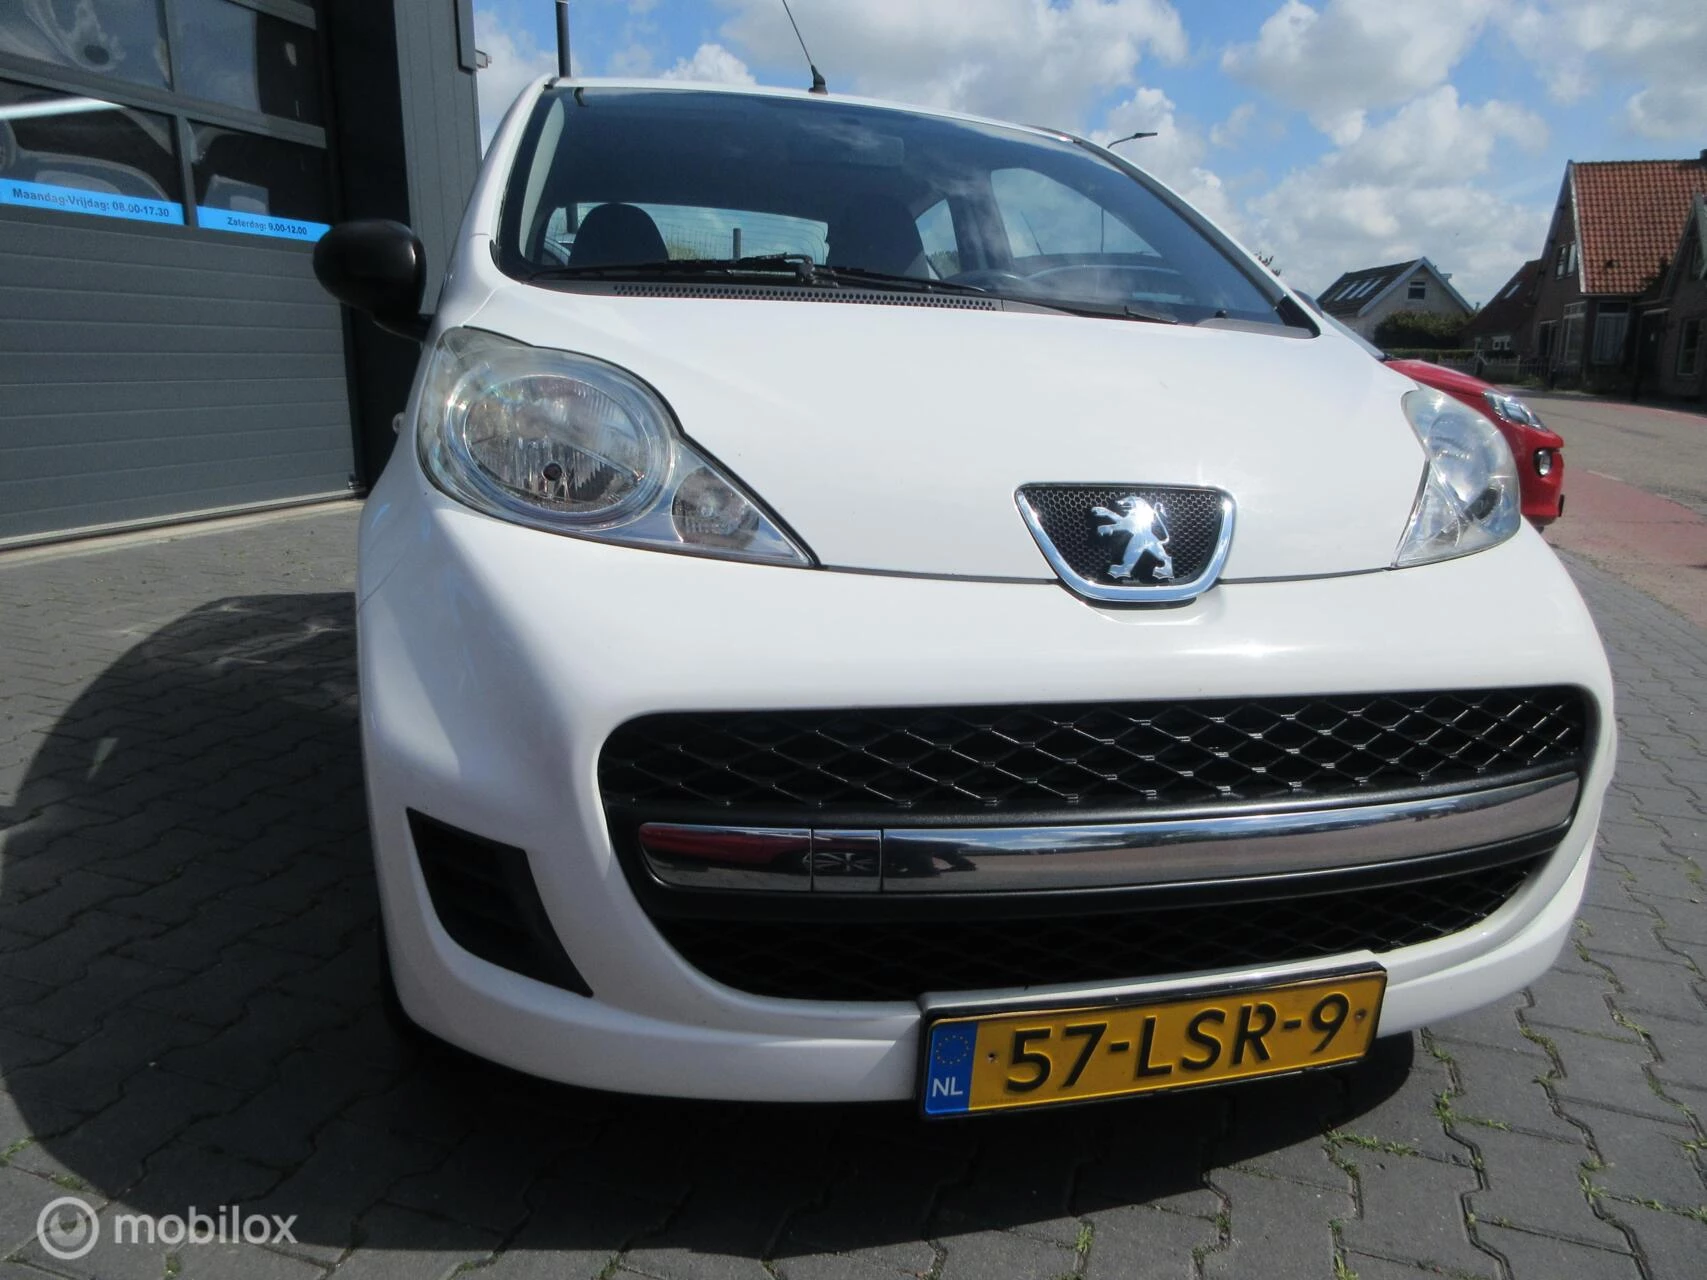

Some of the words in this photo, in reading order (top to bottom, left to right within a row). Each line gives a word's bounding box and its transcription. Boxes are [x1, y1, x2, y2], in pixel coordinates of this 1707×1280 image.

[12, 187, 110, 212] Maandag-Vrijdag:
[112, 201, 170, 217] 08.00-17.30
[227, 216, 267, 232] Zaterdag:
[267, 222, 308, 235] 9.00-12.00
[1005, 992, 1351, 1093] 57-LSR-9
[931, 1076, 963, 1097] NL
